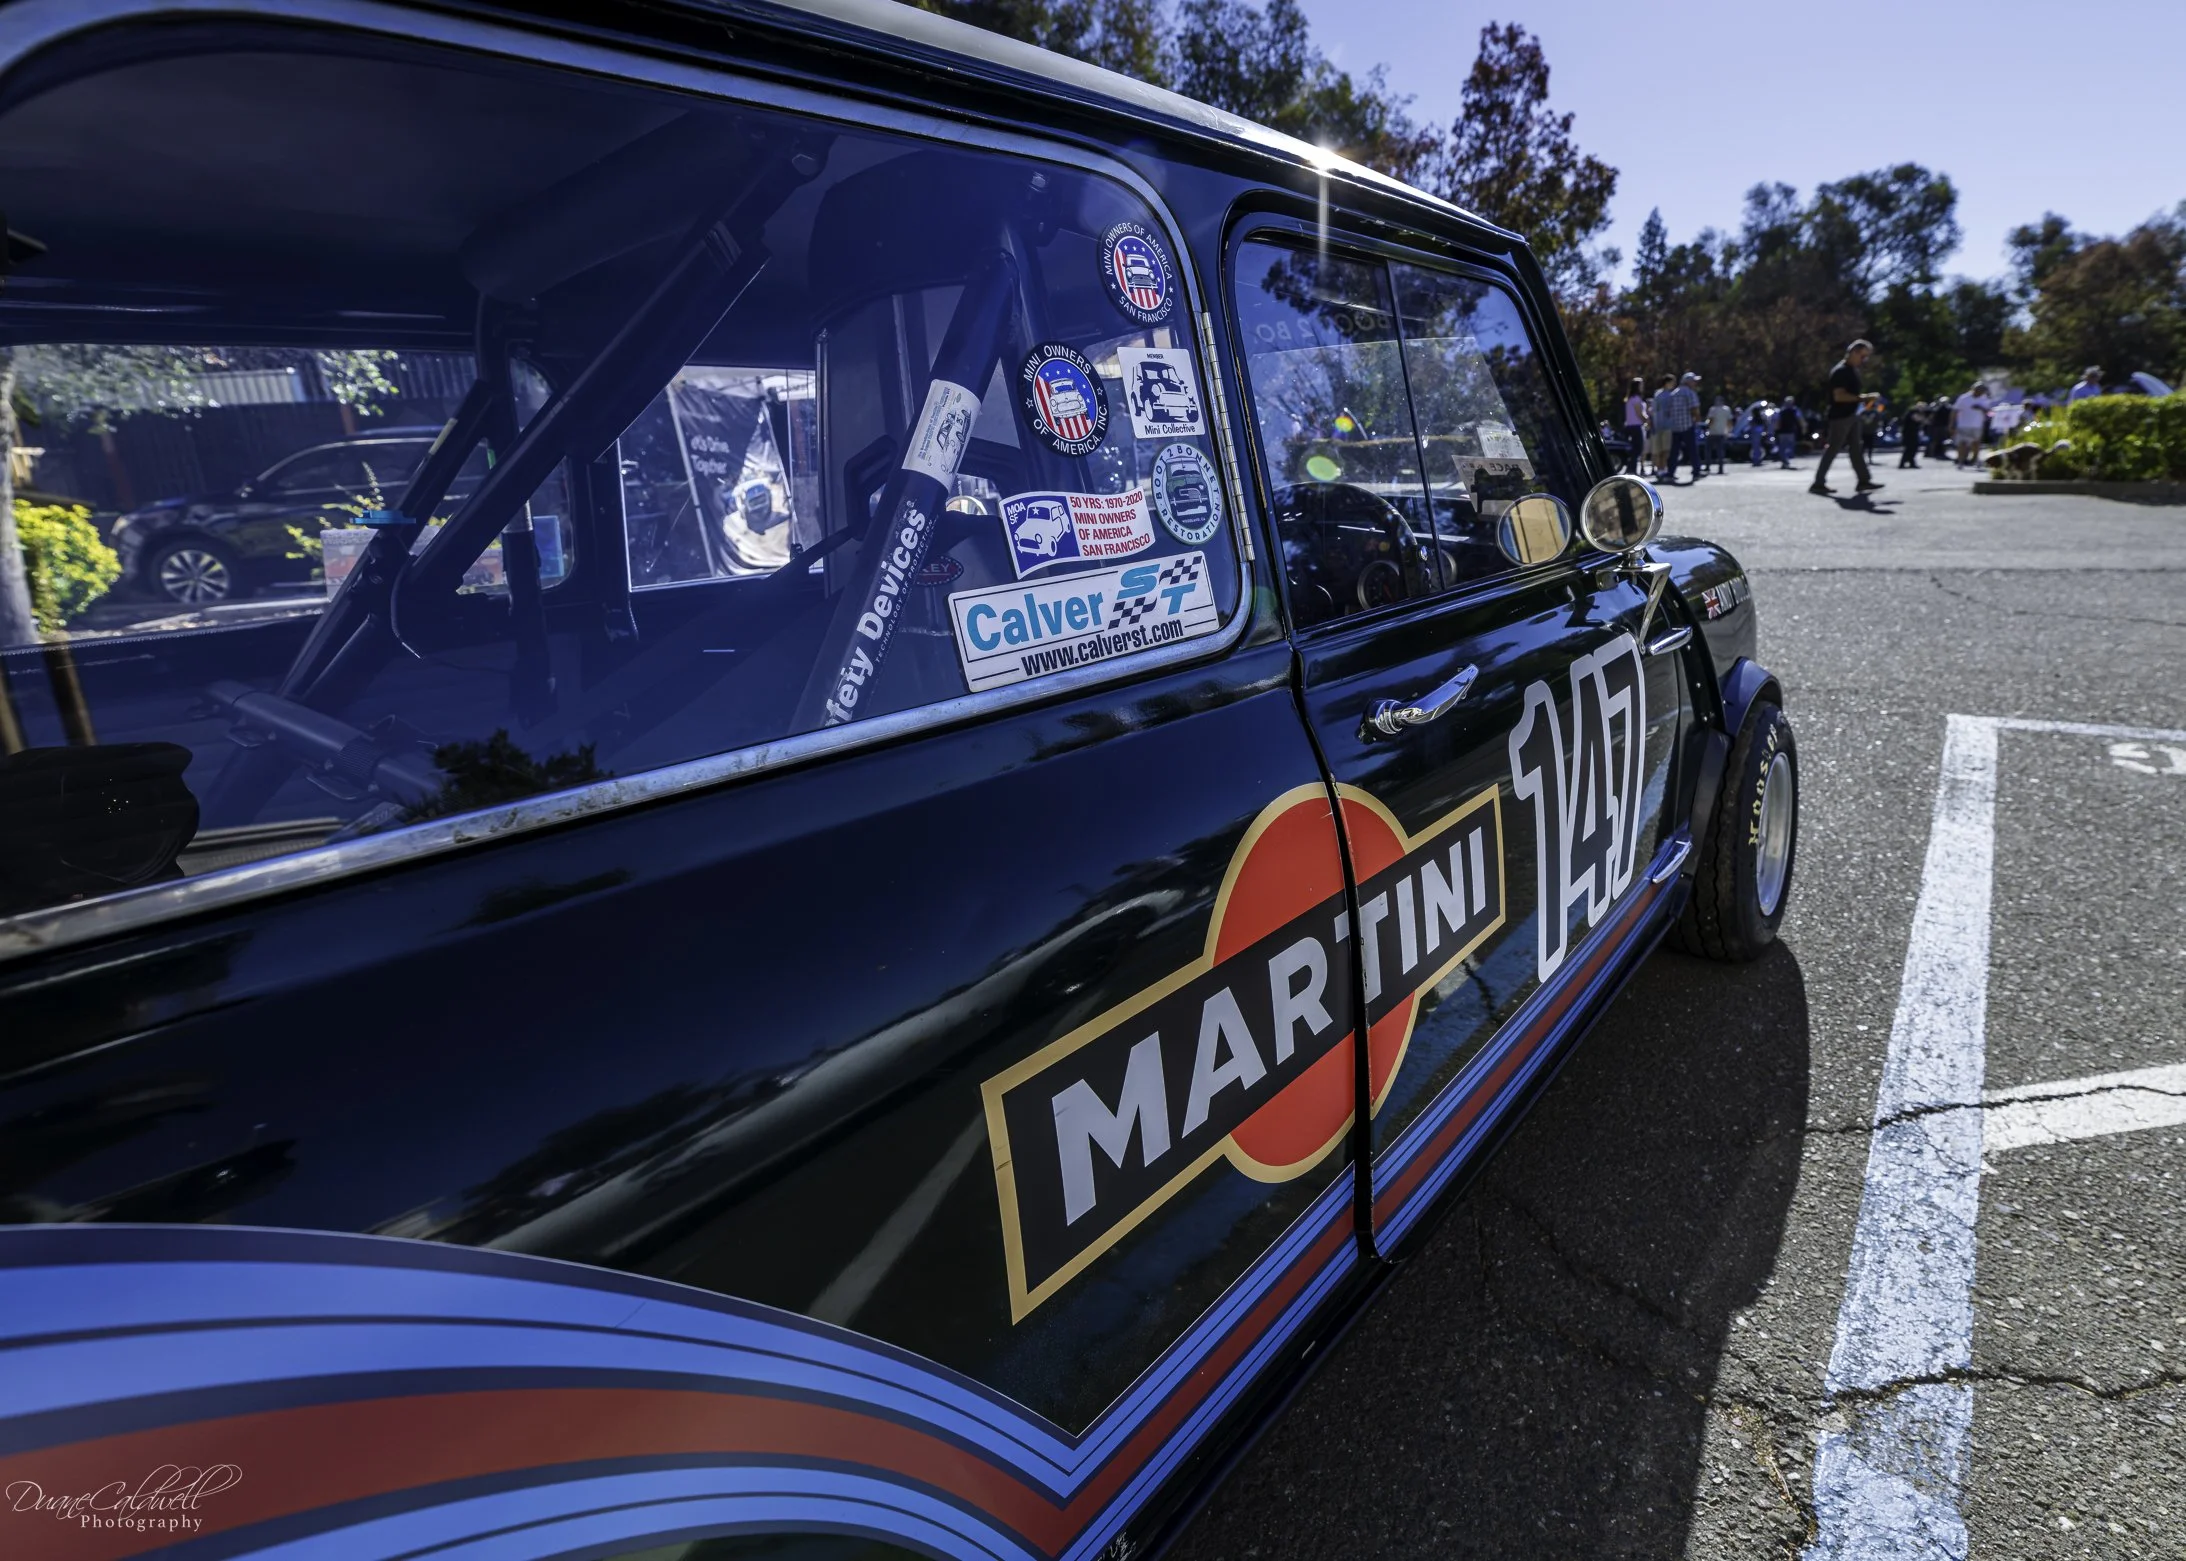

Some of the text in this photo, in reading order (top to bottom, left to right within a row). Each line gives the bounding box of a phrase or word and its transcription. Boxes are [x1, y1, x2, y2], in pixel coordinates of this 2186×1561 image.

[1103, 222, 1173, 279] MINI OWNERS OF AMERICA
[1119, 296, 1173, 323] SAN FRANCISCO
[1023, 345, 1092, 382] MINI OWNERS
[1033, 418, 1049, 436] OF
[1097, 404, 1108, 431] INC.
[1144, 423, 1196, 435] Mini Collective
[1006, 502, 1027, 516] MOA
[1069, 491, 1143, 509] 50 YRS: 1970-2020
[1074, 509, 1137, 525] MINI OWNERS
[1009, 515, 1019, 525] SF
[1078, 525, 1133, 540] OF AMERICA
[1161, 504, 1221, 541] RESTORATION
[1082, 533, 1151, 557] SAN FRANCISCO
[825, 508, 927, 727] fety Devices
[875, 599, 903, 664] TECHNOLOGY
[902, 582, 910, 595] OF
[966, 592, 1104, 651] Calver
[1021, 618, 1184, 676] www.calverst.com
[1508, 632, 1646, 983] 147
[1051, 826, 1487, 1227] MARTINI
